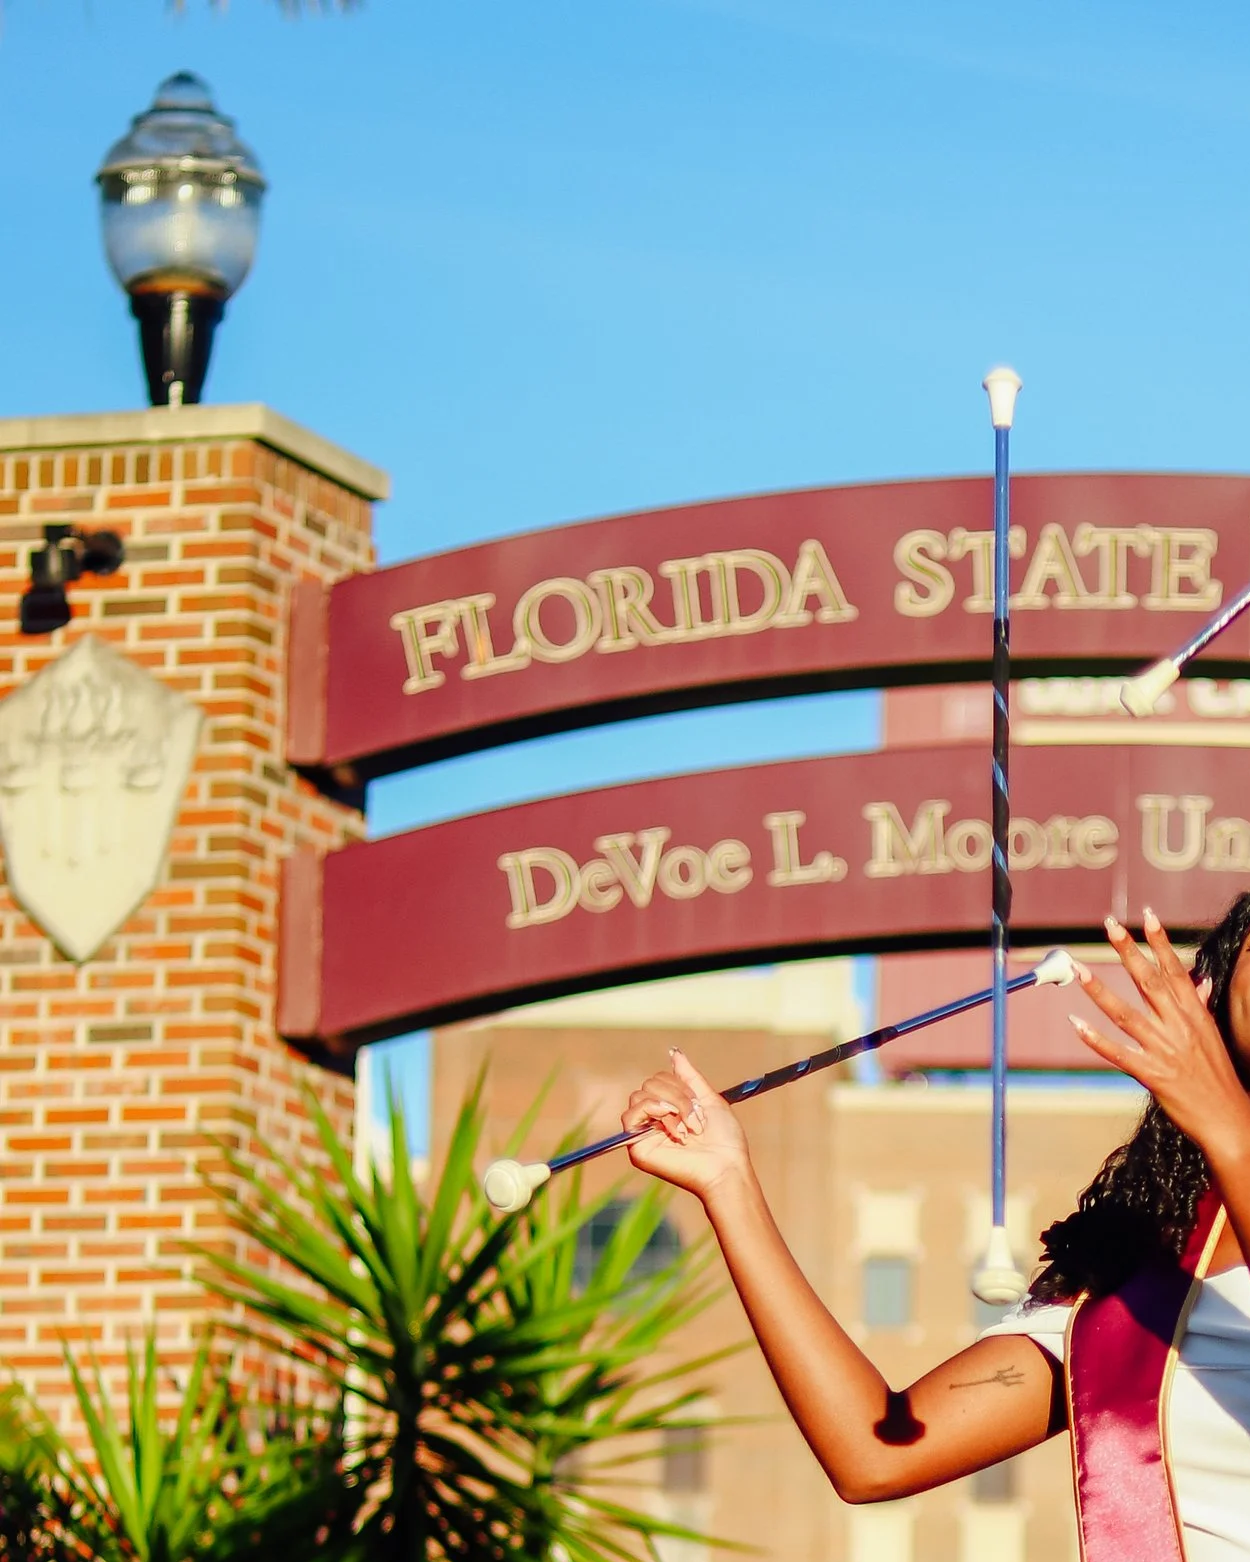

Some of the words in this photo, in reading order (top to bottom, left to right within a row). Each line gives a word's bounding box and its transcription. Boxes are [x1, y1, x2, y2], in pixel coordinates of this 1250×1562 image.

[390, 539, 859, 695] FLORIDA
[893, 523, 1223, 617] STATE
[498, 826, 753, 929] DeVoe
[763, 810, 848, 887] L.
[862, 799, 1119, 878] Moore
